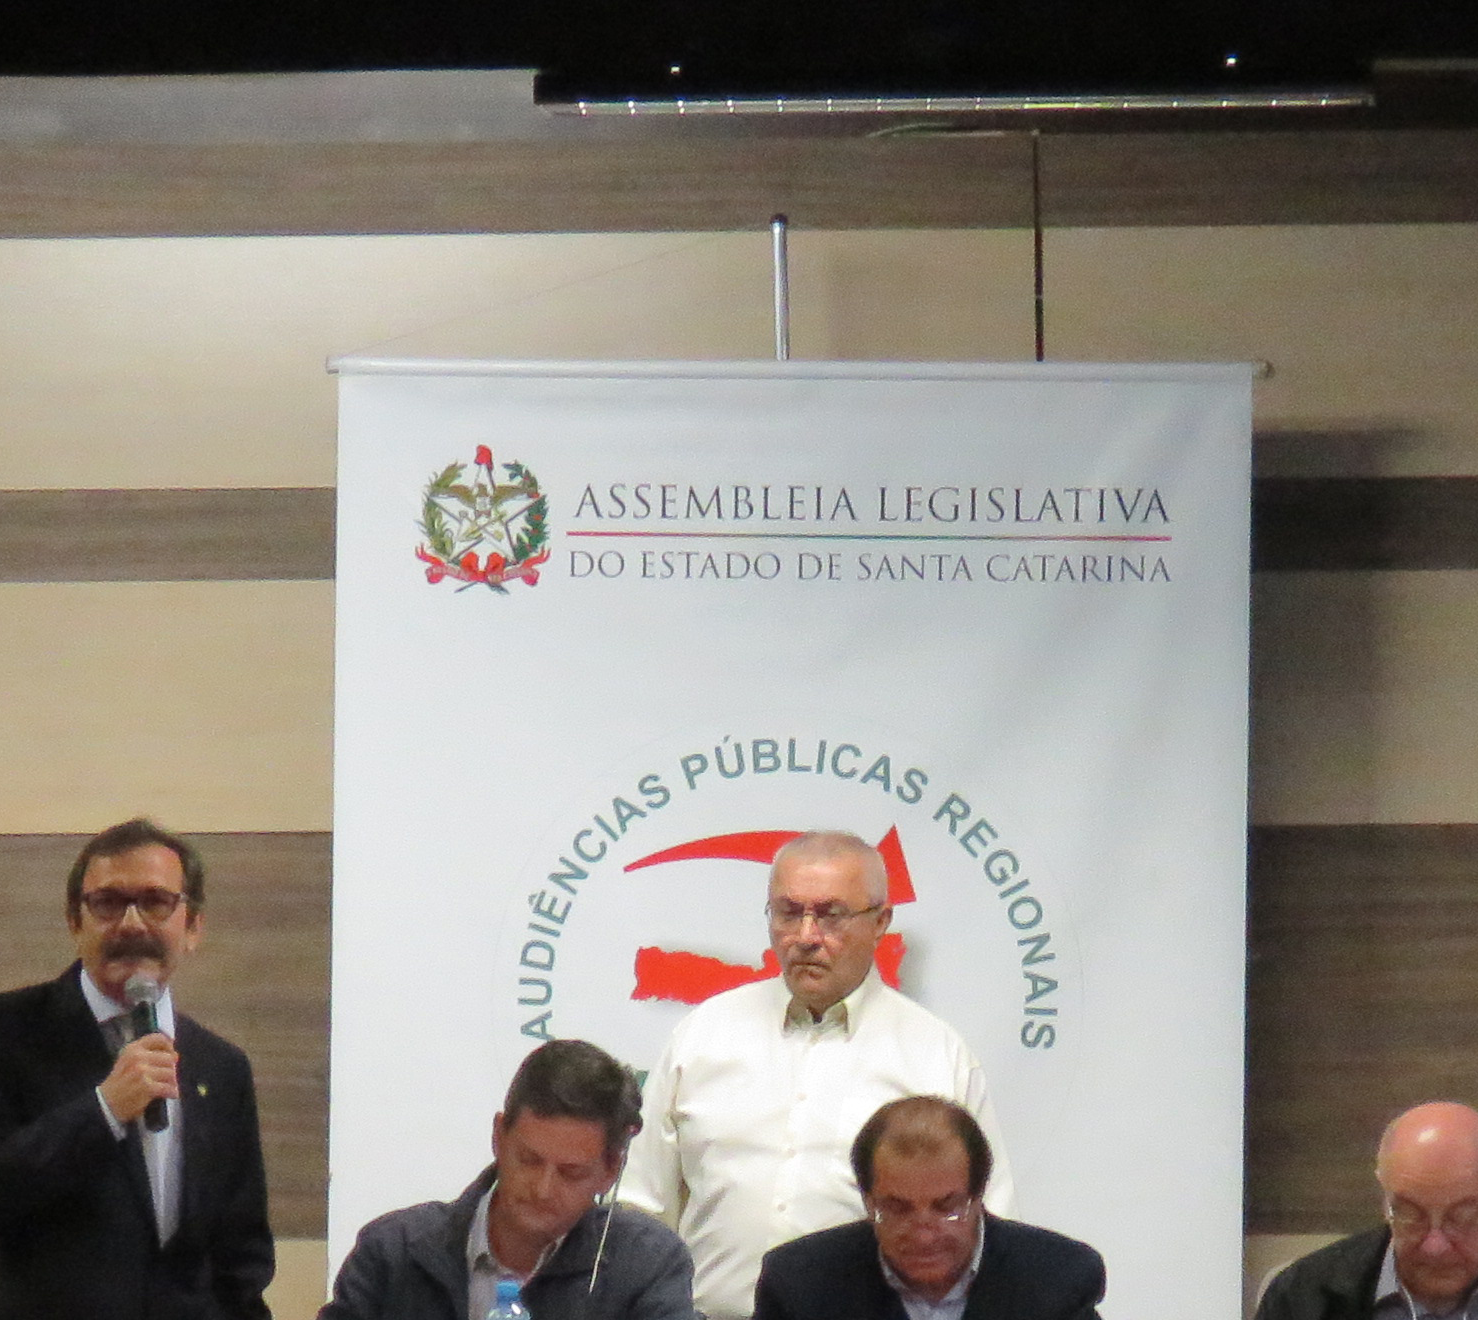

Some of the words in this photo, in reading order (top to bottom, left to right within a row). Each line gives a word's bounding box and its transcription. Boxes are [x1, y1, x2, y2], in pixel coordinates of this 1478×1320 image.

[573, 483, 858, 522] ASSEMBLEIA
[878, 486, 1171, 525] LEGISLATIVA
[569, 550, 626, 580] DO
[640, 550, 782, 581] ESTADO
[797, 552, 842, 581] DE
[857, 553, 974, 583] SANTA
[986, 554, 1172, 583] CATARINA
[518, 773, 672, 1042] AUDIÊNCIAS
[679, 734, 929, 805] PÚBLICAS
[932, 792, 1059, 1051] REGIONAIS
